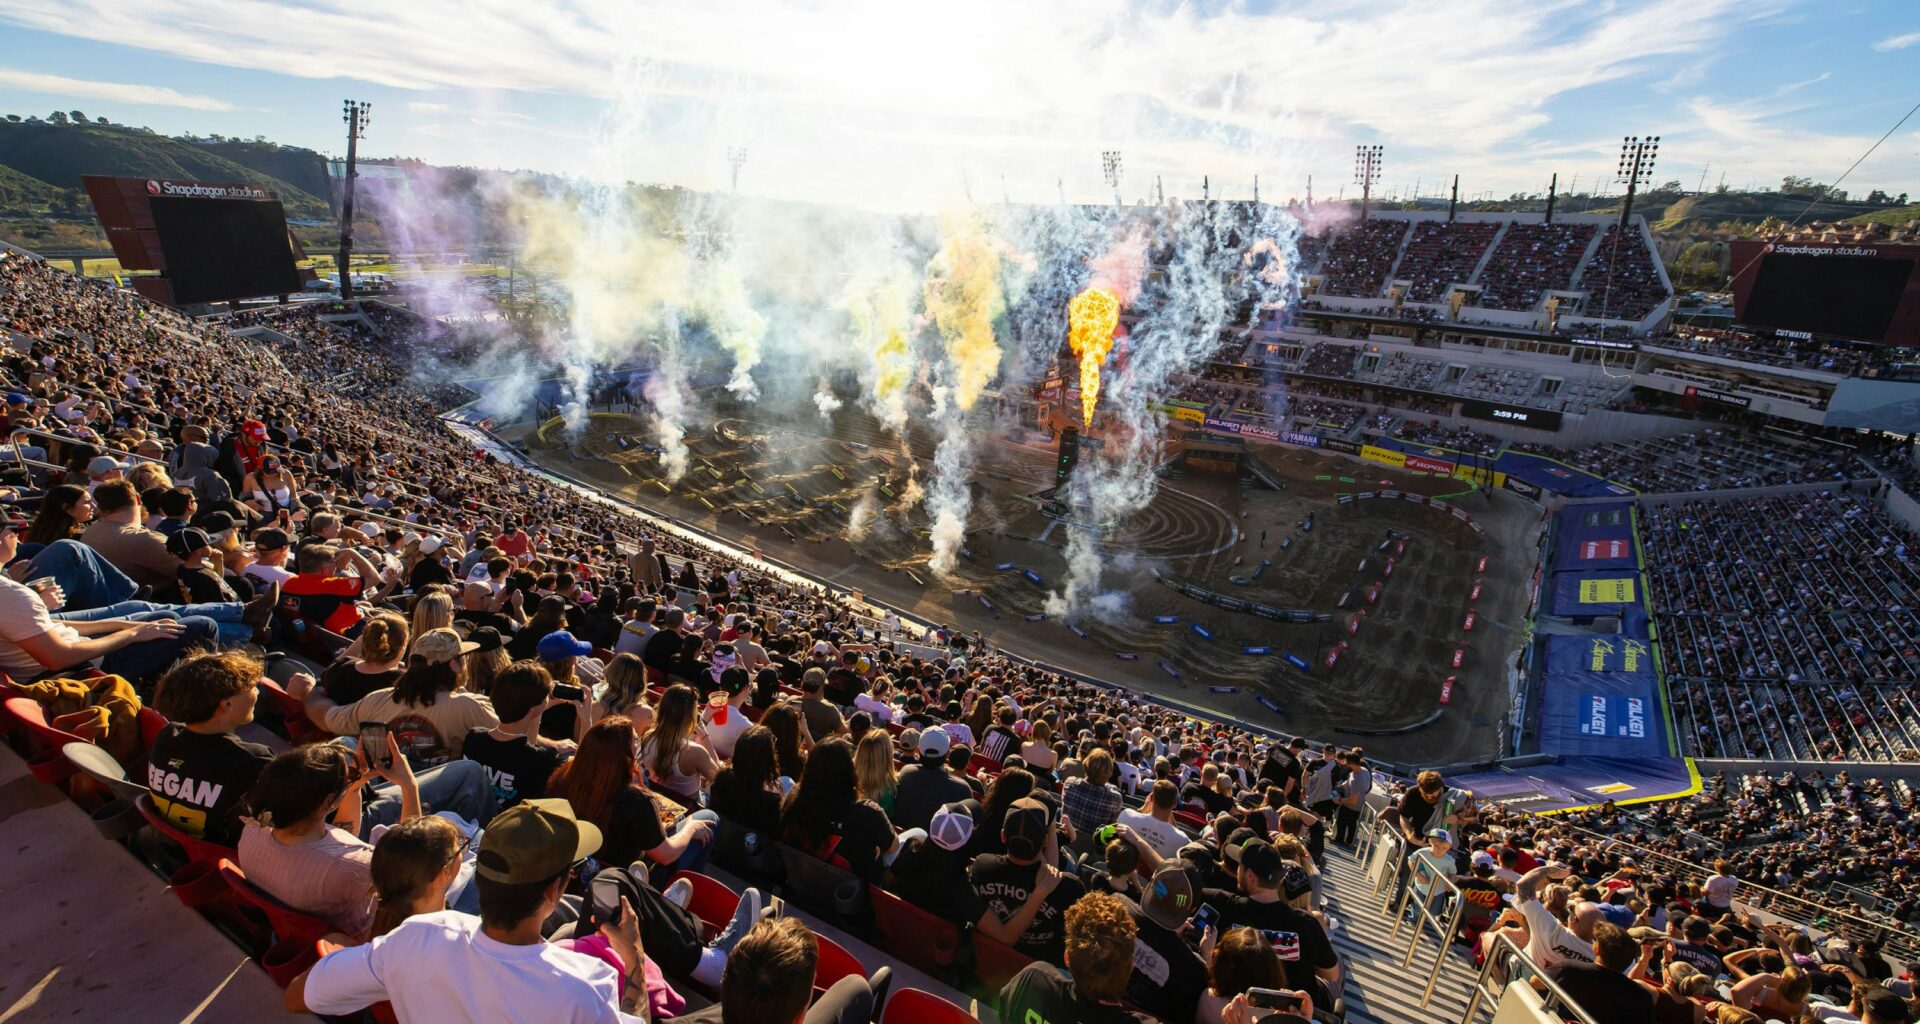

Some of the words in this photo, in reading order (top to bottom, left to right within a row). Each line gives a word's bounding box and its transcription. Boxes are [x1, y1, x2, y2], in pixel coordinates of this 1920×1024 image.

[163, 182, 226, 198] Snapdragon
[228, 186, 265, 198] stadium
[1776, 245, 1833, 256] Snapdragon
[1835, 247, 1877, 256] stadium
[1775, 329, 1812, 340] CUTWATER
[1697, 390, 1718, 399] TOYOTA
[1720, 395, 1747, 406] TERRACE
[1493, 410, 1512, 419] 3:59
[1513, 413, 1527, 421] PM
[1206, 418, 1239, 429] FALKEN
[1290, 433, 1317, 445] YAMAHA
[1370, 451, 1403, 463] DUNLOP
[1416, 461, 1451, 474] HONDA
[1592, 696, 1606, 735] FALKEN
[1628, 698, 1645, 738] FALKEN
[148, 760, 223, 809] EEGAN
[971, 882, 1058, 920] ASTHOSE
[1677, 949, 1718, 969] FASTHOUSE
